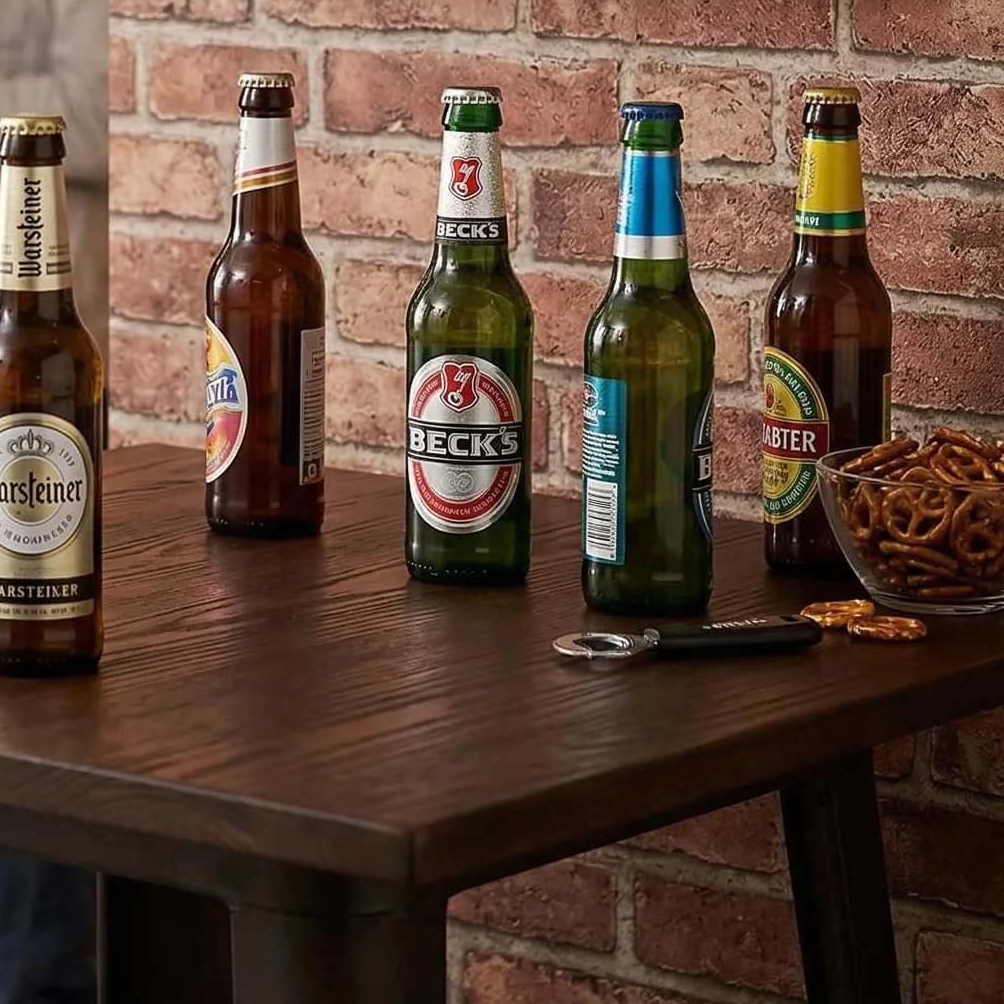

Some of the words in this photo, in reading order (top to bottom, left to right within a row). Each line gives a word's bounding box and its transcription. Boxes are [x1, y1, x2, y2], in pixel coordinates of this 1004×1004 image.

[16, 177, 45, 279] Warsteiner
[437, 221, 500, 239] BECK'S
[408, 425, 519, 457] BECK'S
